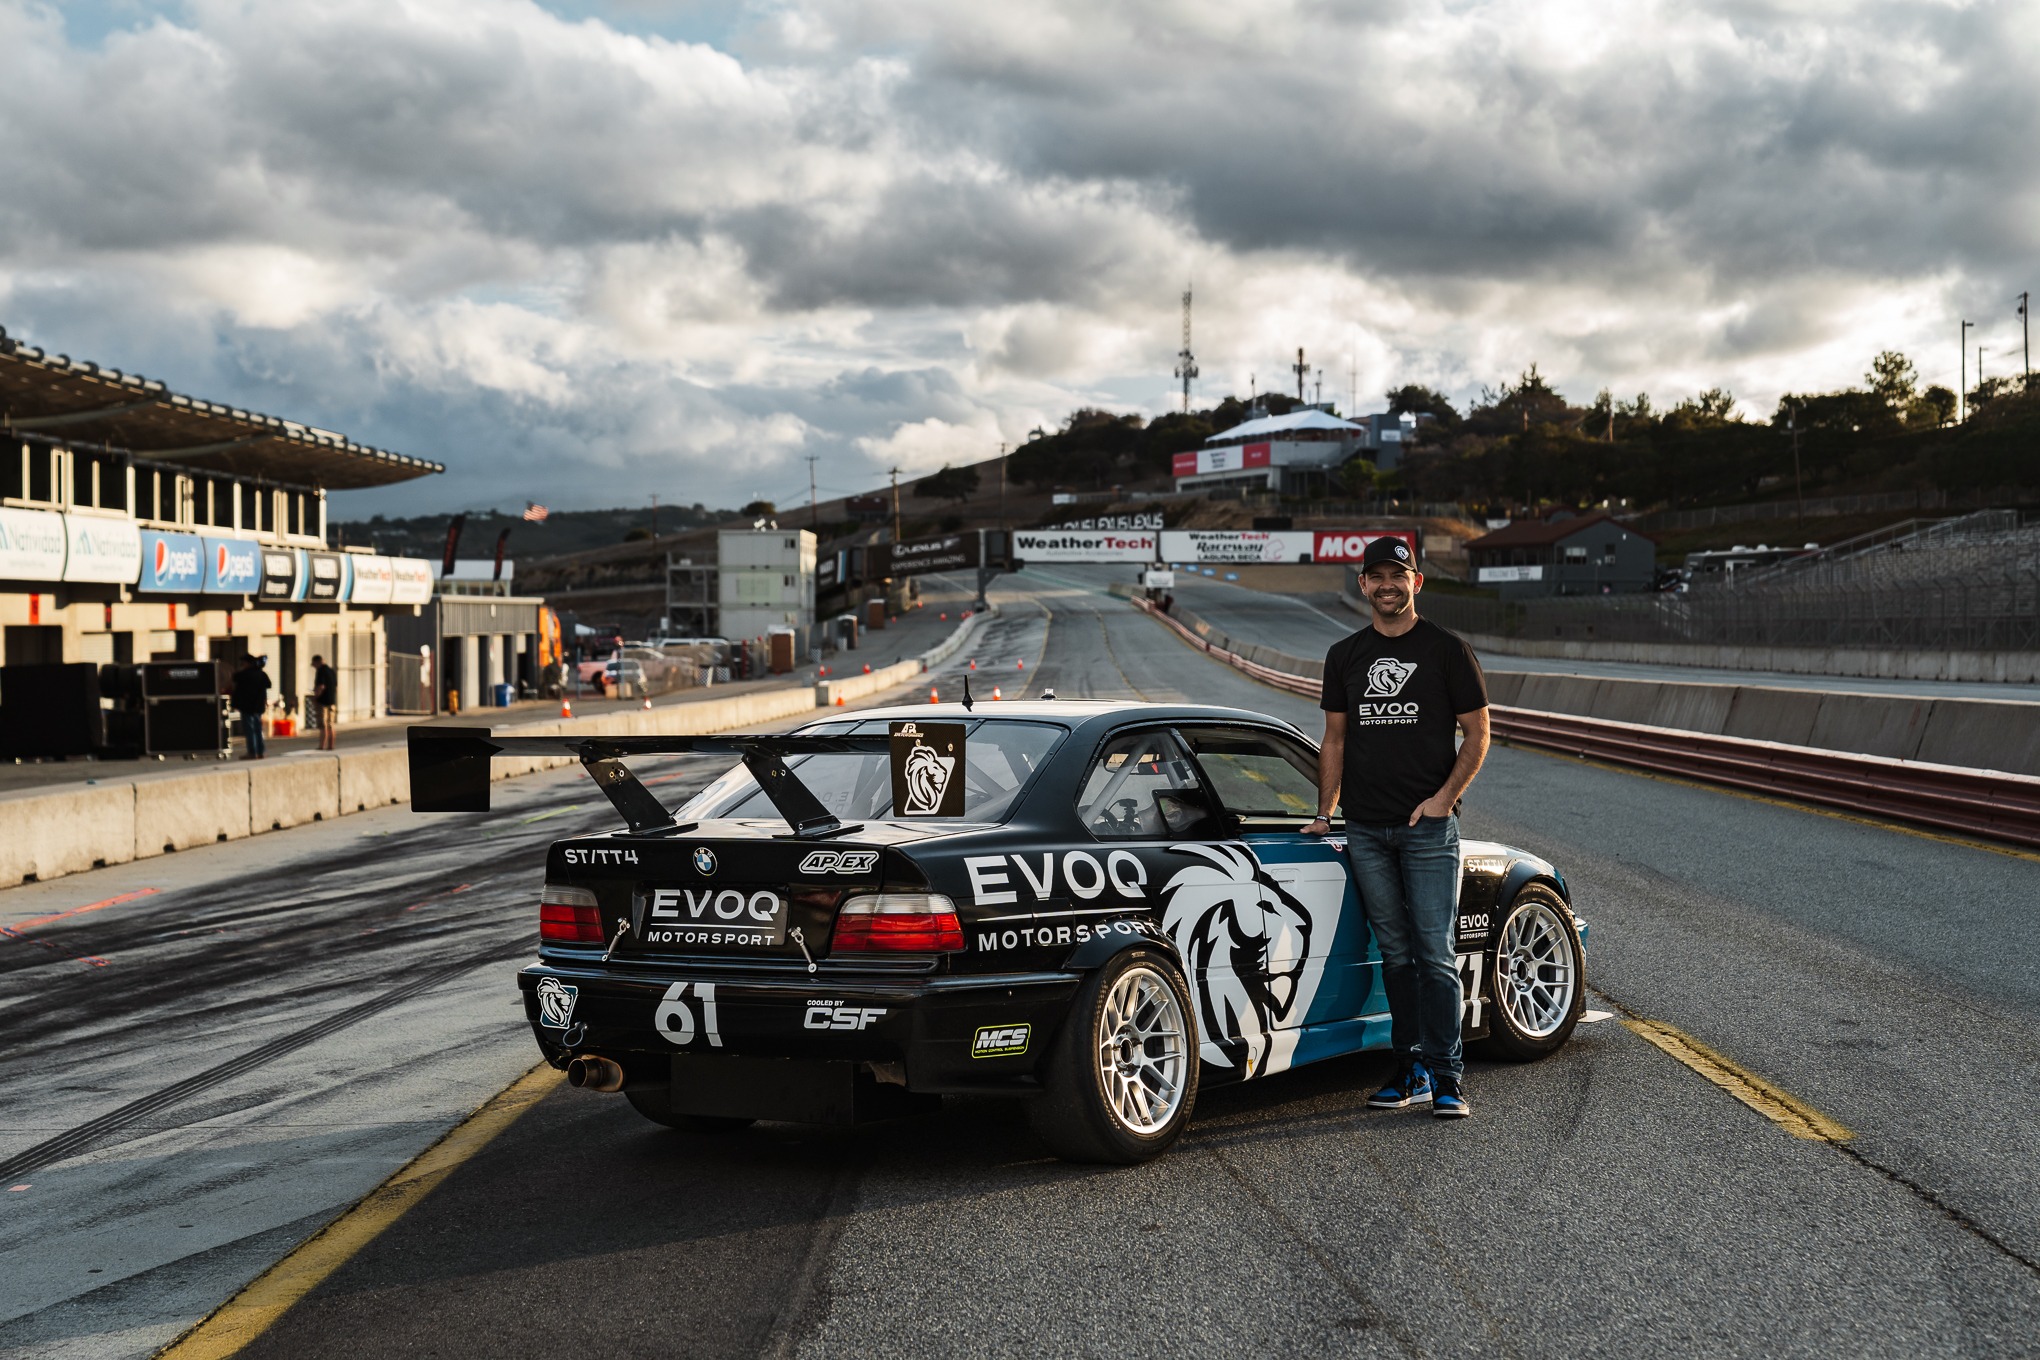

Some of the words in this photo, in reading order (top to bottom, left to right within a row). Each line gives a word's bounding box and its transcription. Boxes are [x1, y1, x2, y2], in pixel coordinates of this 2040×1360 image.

[1017, 536, 1153, 549] WeatherTech
[1189, 533, 1269, 541] WeatherTech
[1197, 542, 1264, 553] Raceway
[168, 547, 198, 581] pepsi
[229, 551, 255, 583] pepsi
[1359, 702, 1419, 716] EVOQ
[1360, 718, 1418, 726] MOTORSPORT
[564, 848, 639, 865] ST/TT4
[802, 854, 875, 870] APEX
[964, 850, 1148, 905] EVOQ
[651, 888, 780, 922] EVOQ
[1460, 913, 1489, 929] EVOQ
[648, 931, 775, 946] MOTORSPORT
[978, 921, 1160, 952] MOTORSPORT
[1460, 931, 1489, 940] MOTORSPORT
[654, 981, 723, 1047] 61
[803, 1007, 887, 1030] CSF
[975, 1027, 1028, 1049] MCS
